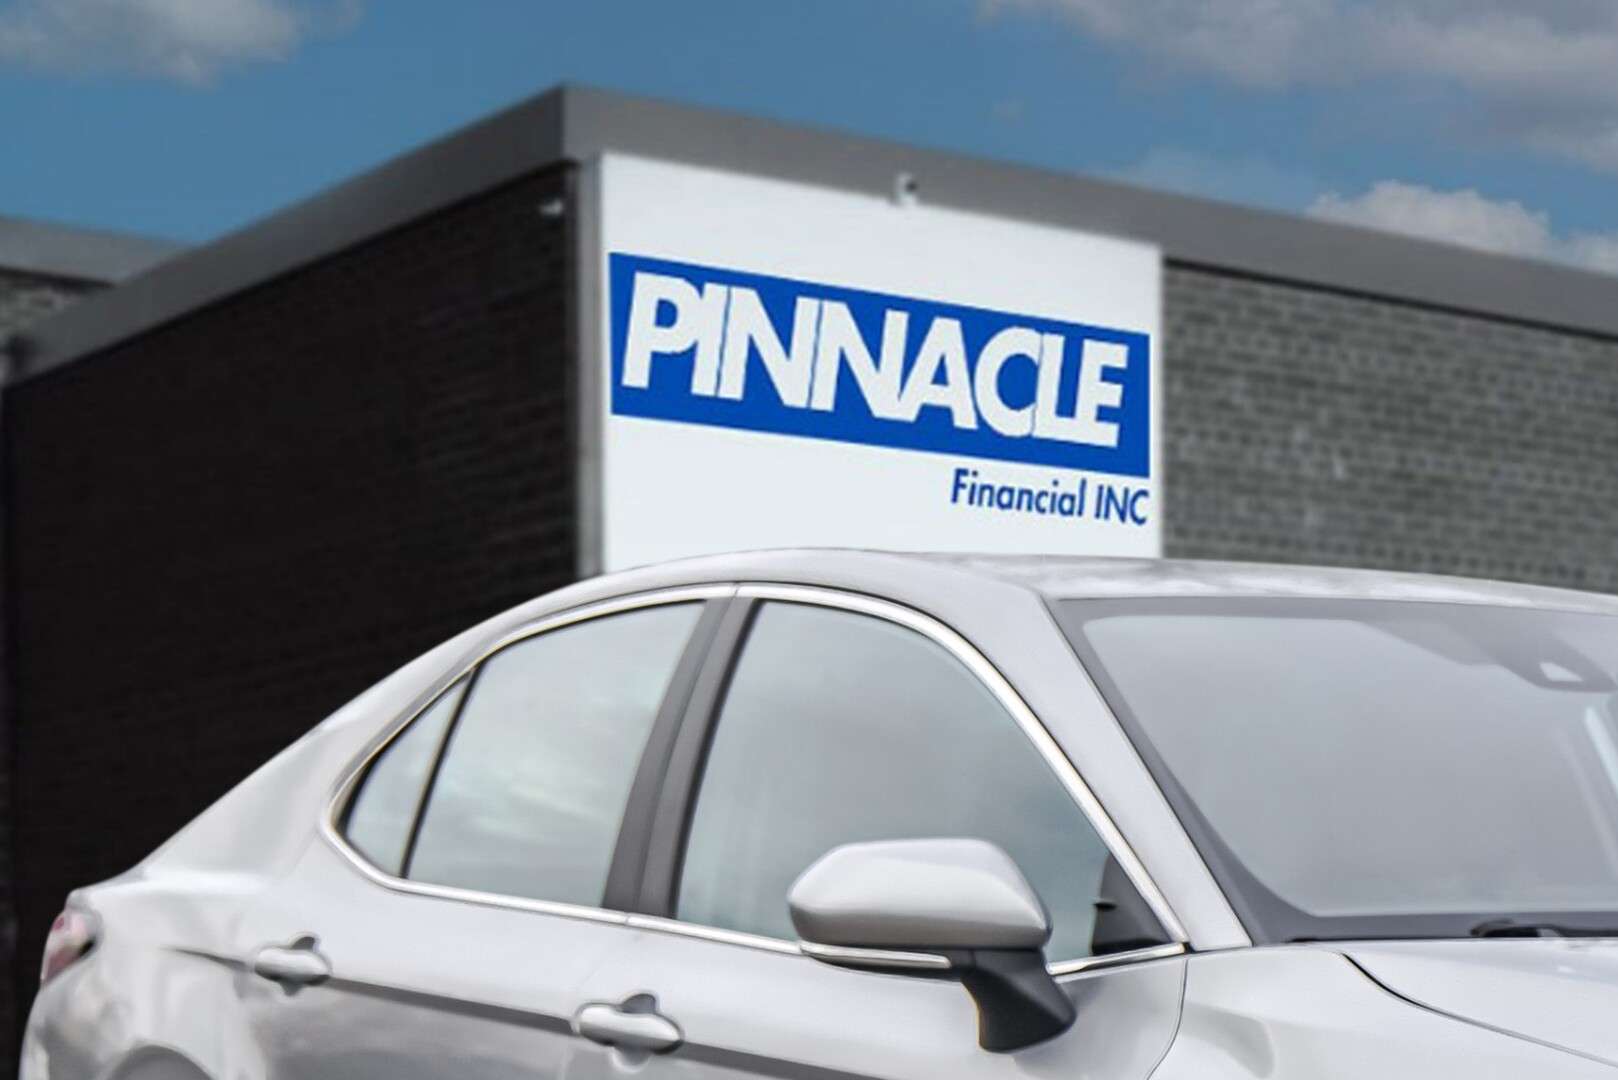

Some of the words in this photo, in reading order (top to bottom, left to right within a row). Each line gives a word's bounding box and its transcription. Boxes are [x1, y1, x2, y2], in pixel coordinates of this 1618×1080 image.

[621, 271, 1129, 448] PINNACLE
[951, 468, 1086, 518] Financial
[1094, 485, 1150, 525] INC
